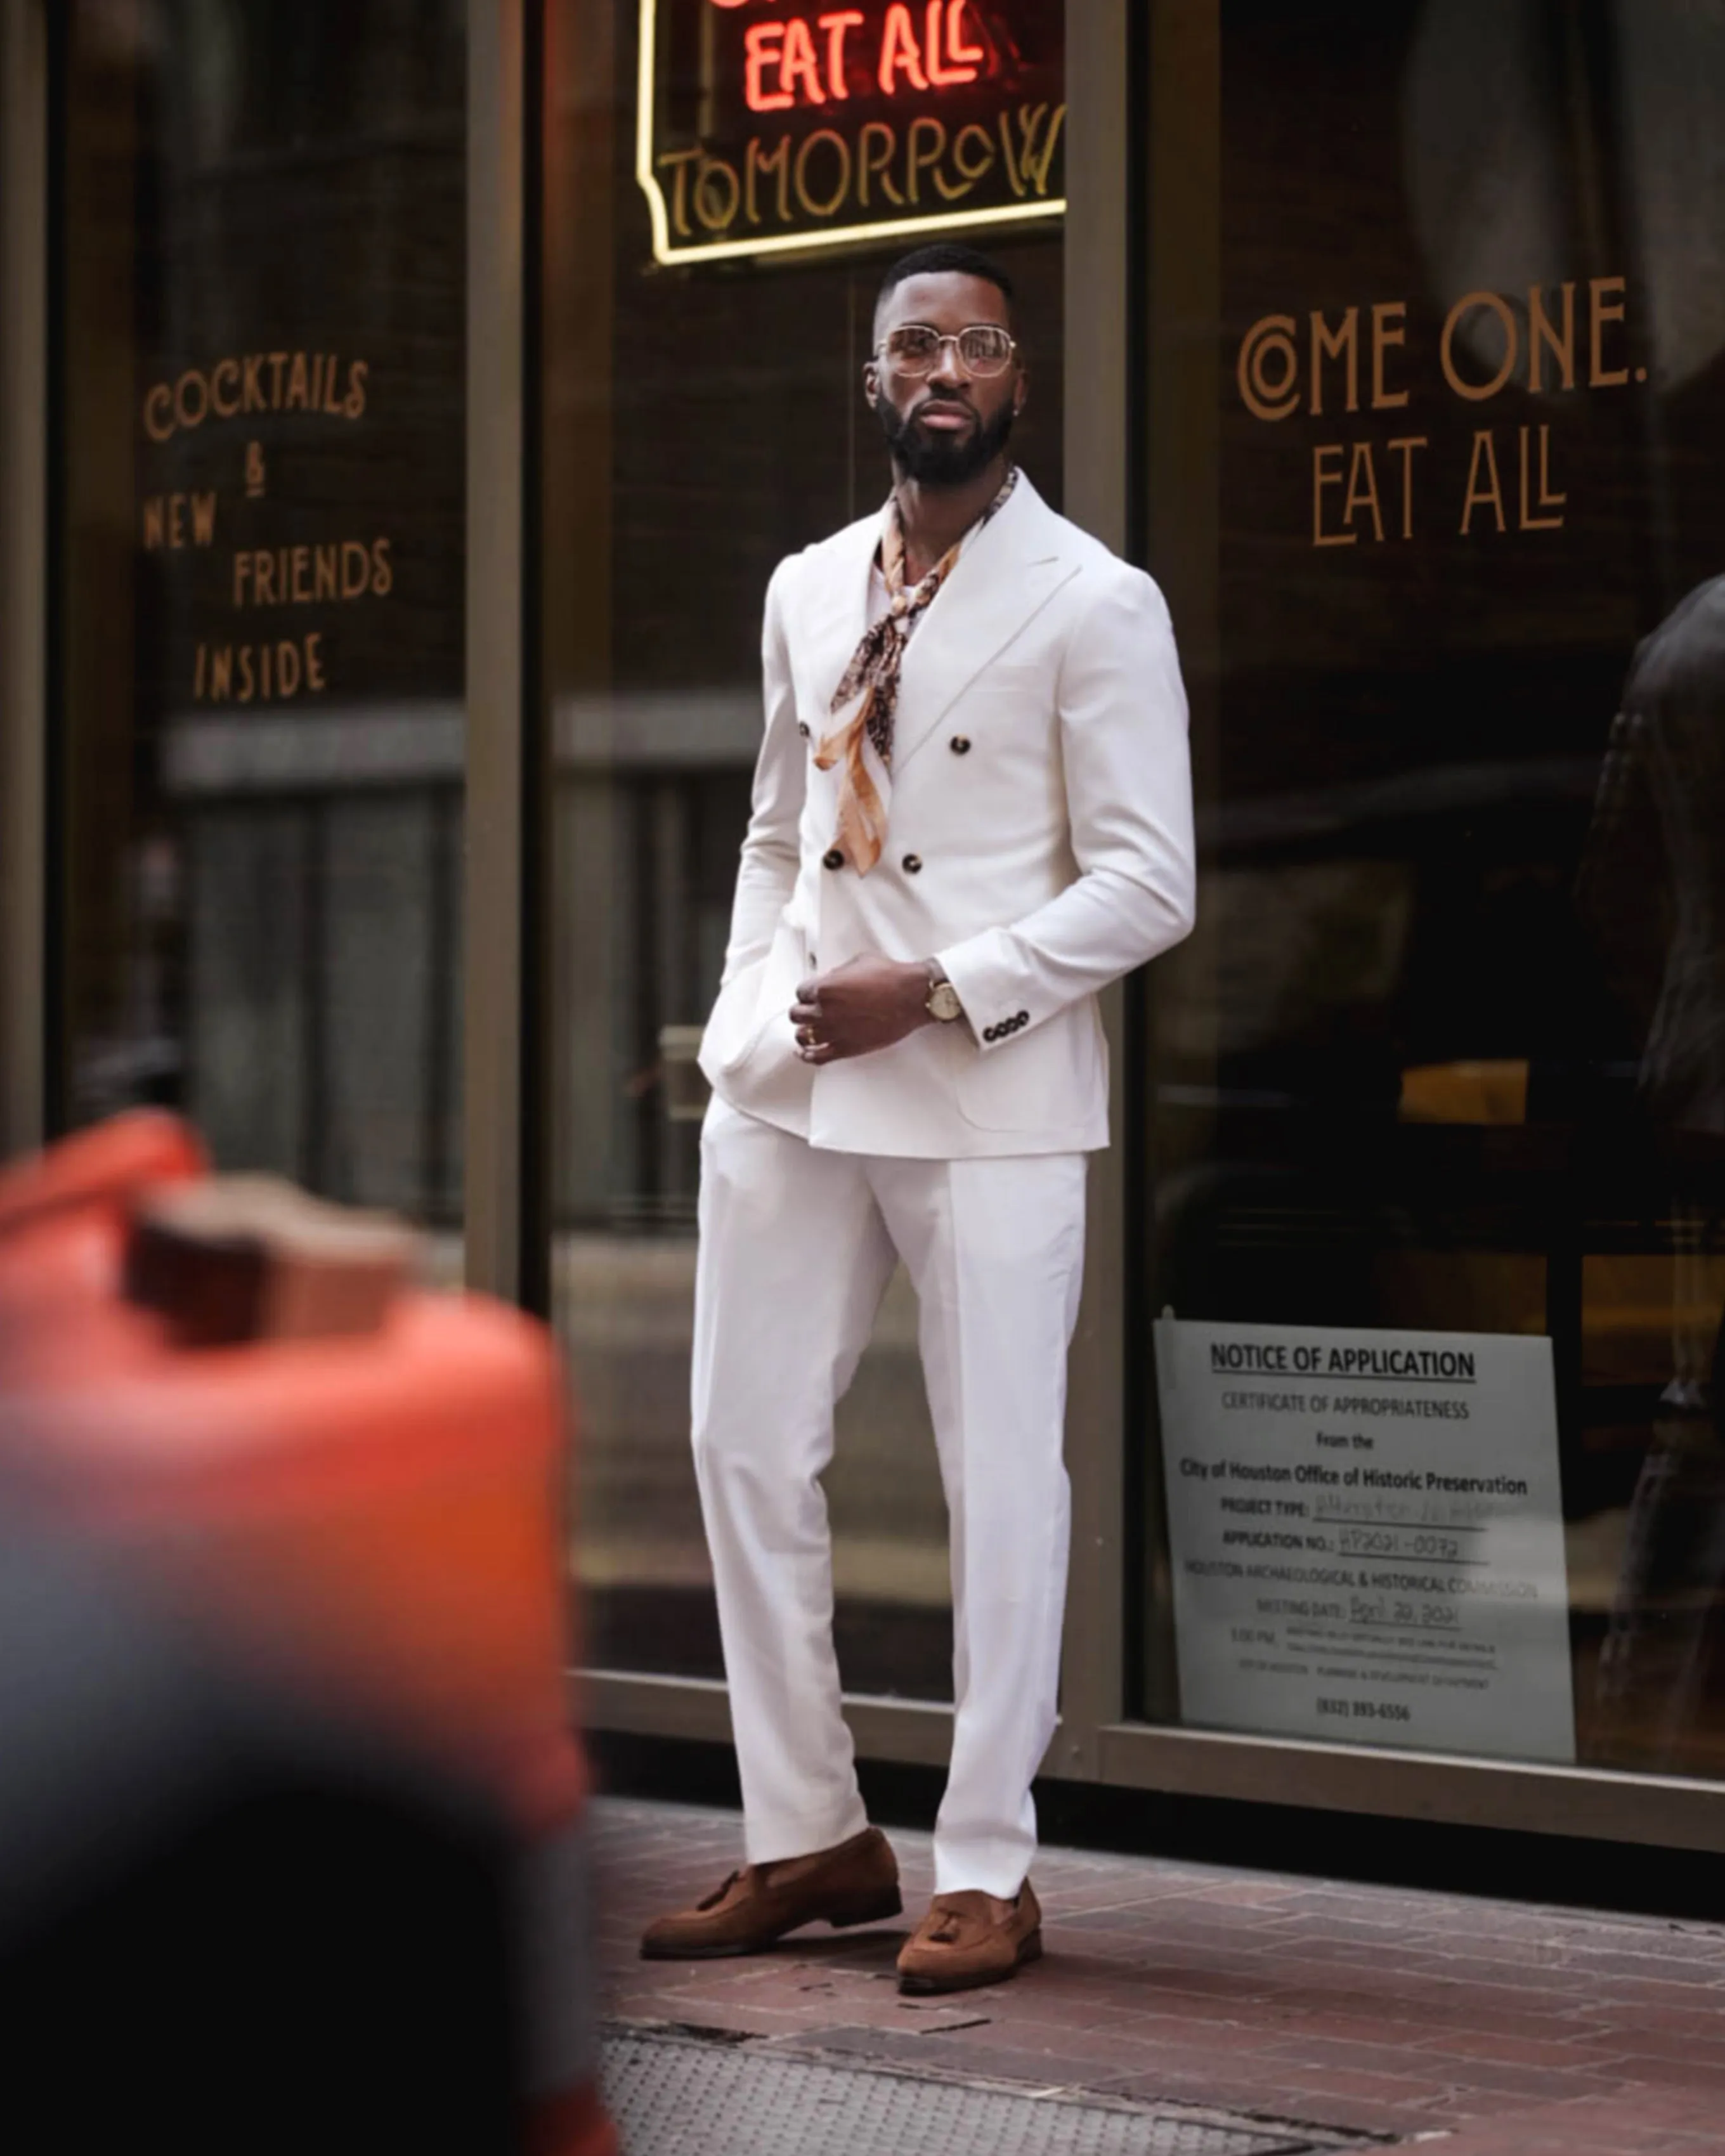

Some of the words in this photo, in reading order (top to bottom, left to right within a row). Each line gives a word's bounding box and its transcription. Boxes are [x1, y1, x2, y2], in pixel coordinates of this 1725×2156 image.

[745, 13, 864, 112] EAT
[878, 0, 983, 94] ALL
[658, 103, 1067, 235] TOMORROW
[1237, 302, 1409, 420] COME
[1441, 276, 1647, 401] ONE.
[143, 351, 369, 441] COCKTAILS
[245, 439, 266, 498] &
[1313, 436, 1428, 546] EAT
[1459, 424, 1566, 535] ALL
[143, 491, 216, 550] NEW
[233, 535, 394, 609] FRIENDS
[193, 632, 326, 703] INSIDE
[1210, 1342, 1287, 1370] NOTICE
[1293, 1346, 1322, 1372] OF
[1328, 1346, 1476, 1377] APPLICATION
[1221, 1391, 1306, 1413] CERTIFICATE
[1310, 1394, 1329, 1413] OF
[1334, 1395, 1470, 1420] APPROPRIATENESS
[1316, 1431, 1349, 1448] From
[1352, 1432, 1374, 1450] the
[1179, 1457, 1208, 1481] City
[1212, 1459, 1227, 1479] of
[1229, 1461, 1292, 1483] Houston
[1295, 1464, 1340, 1484] Office
[1343, 1467, 1359, 1487] of
[1363, 1469, 1423, 1490] Historic
[1426, 1472, 1528, 1497] Preservation
[1222, 1529, 1303, 1550] APPLICATION
[1371, 1573, 1447, 1594] HISTORICAL
